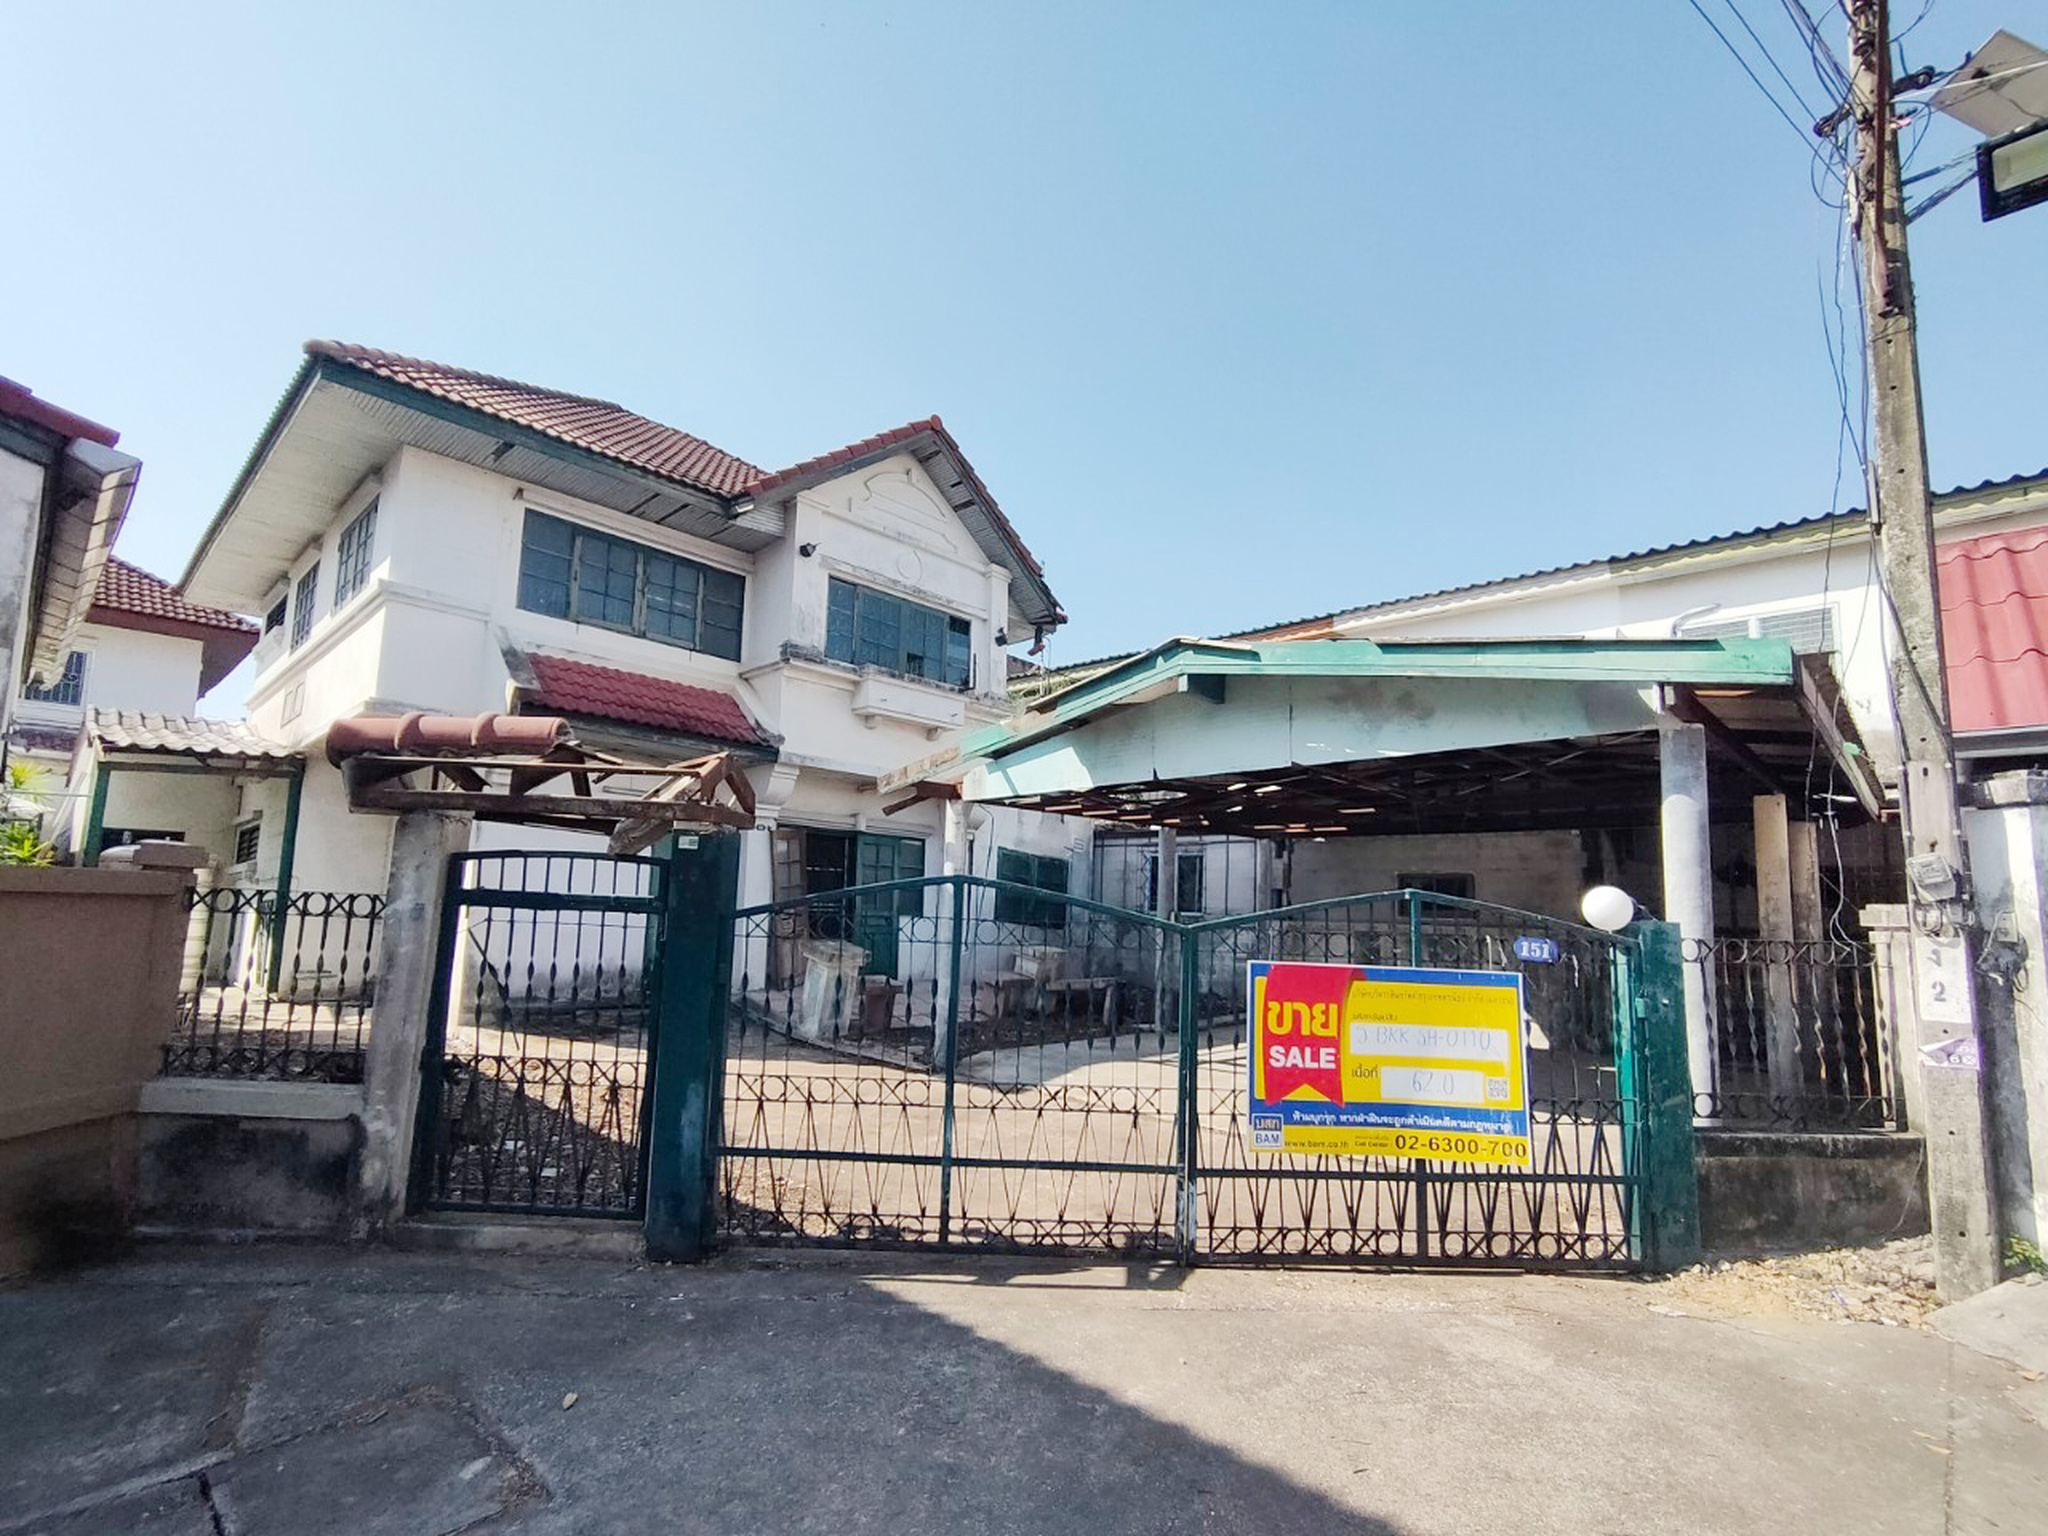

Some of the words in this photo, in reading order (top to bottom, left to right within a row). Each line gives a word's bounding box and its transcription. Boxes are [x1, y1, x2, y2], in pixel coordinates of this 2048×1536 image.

[1521, 941, 1550, 959] 151
[1267, 1001, 1338, 1037] ขาย
[1269, 1046, 1336, 1069] SALE
[1255, 1132, 1280, 1145] BAM
[1395, 1134, 1527, 1158] 02-6300-700
